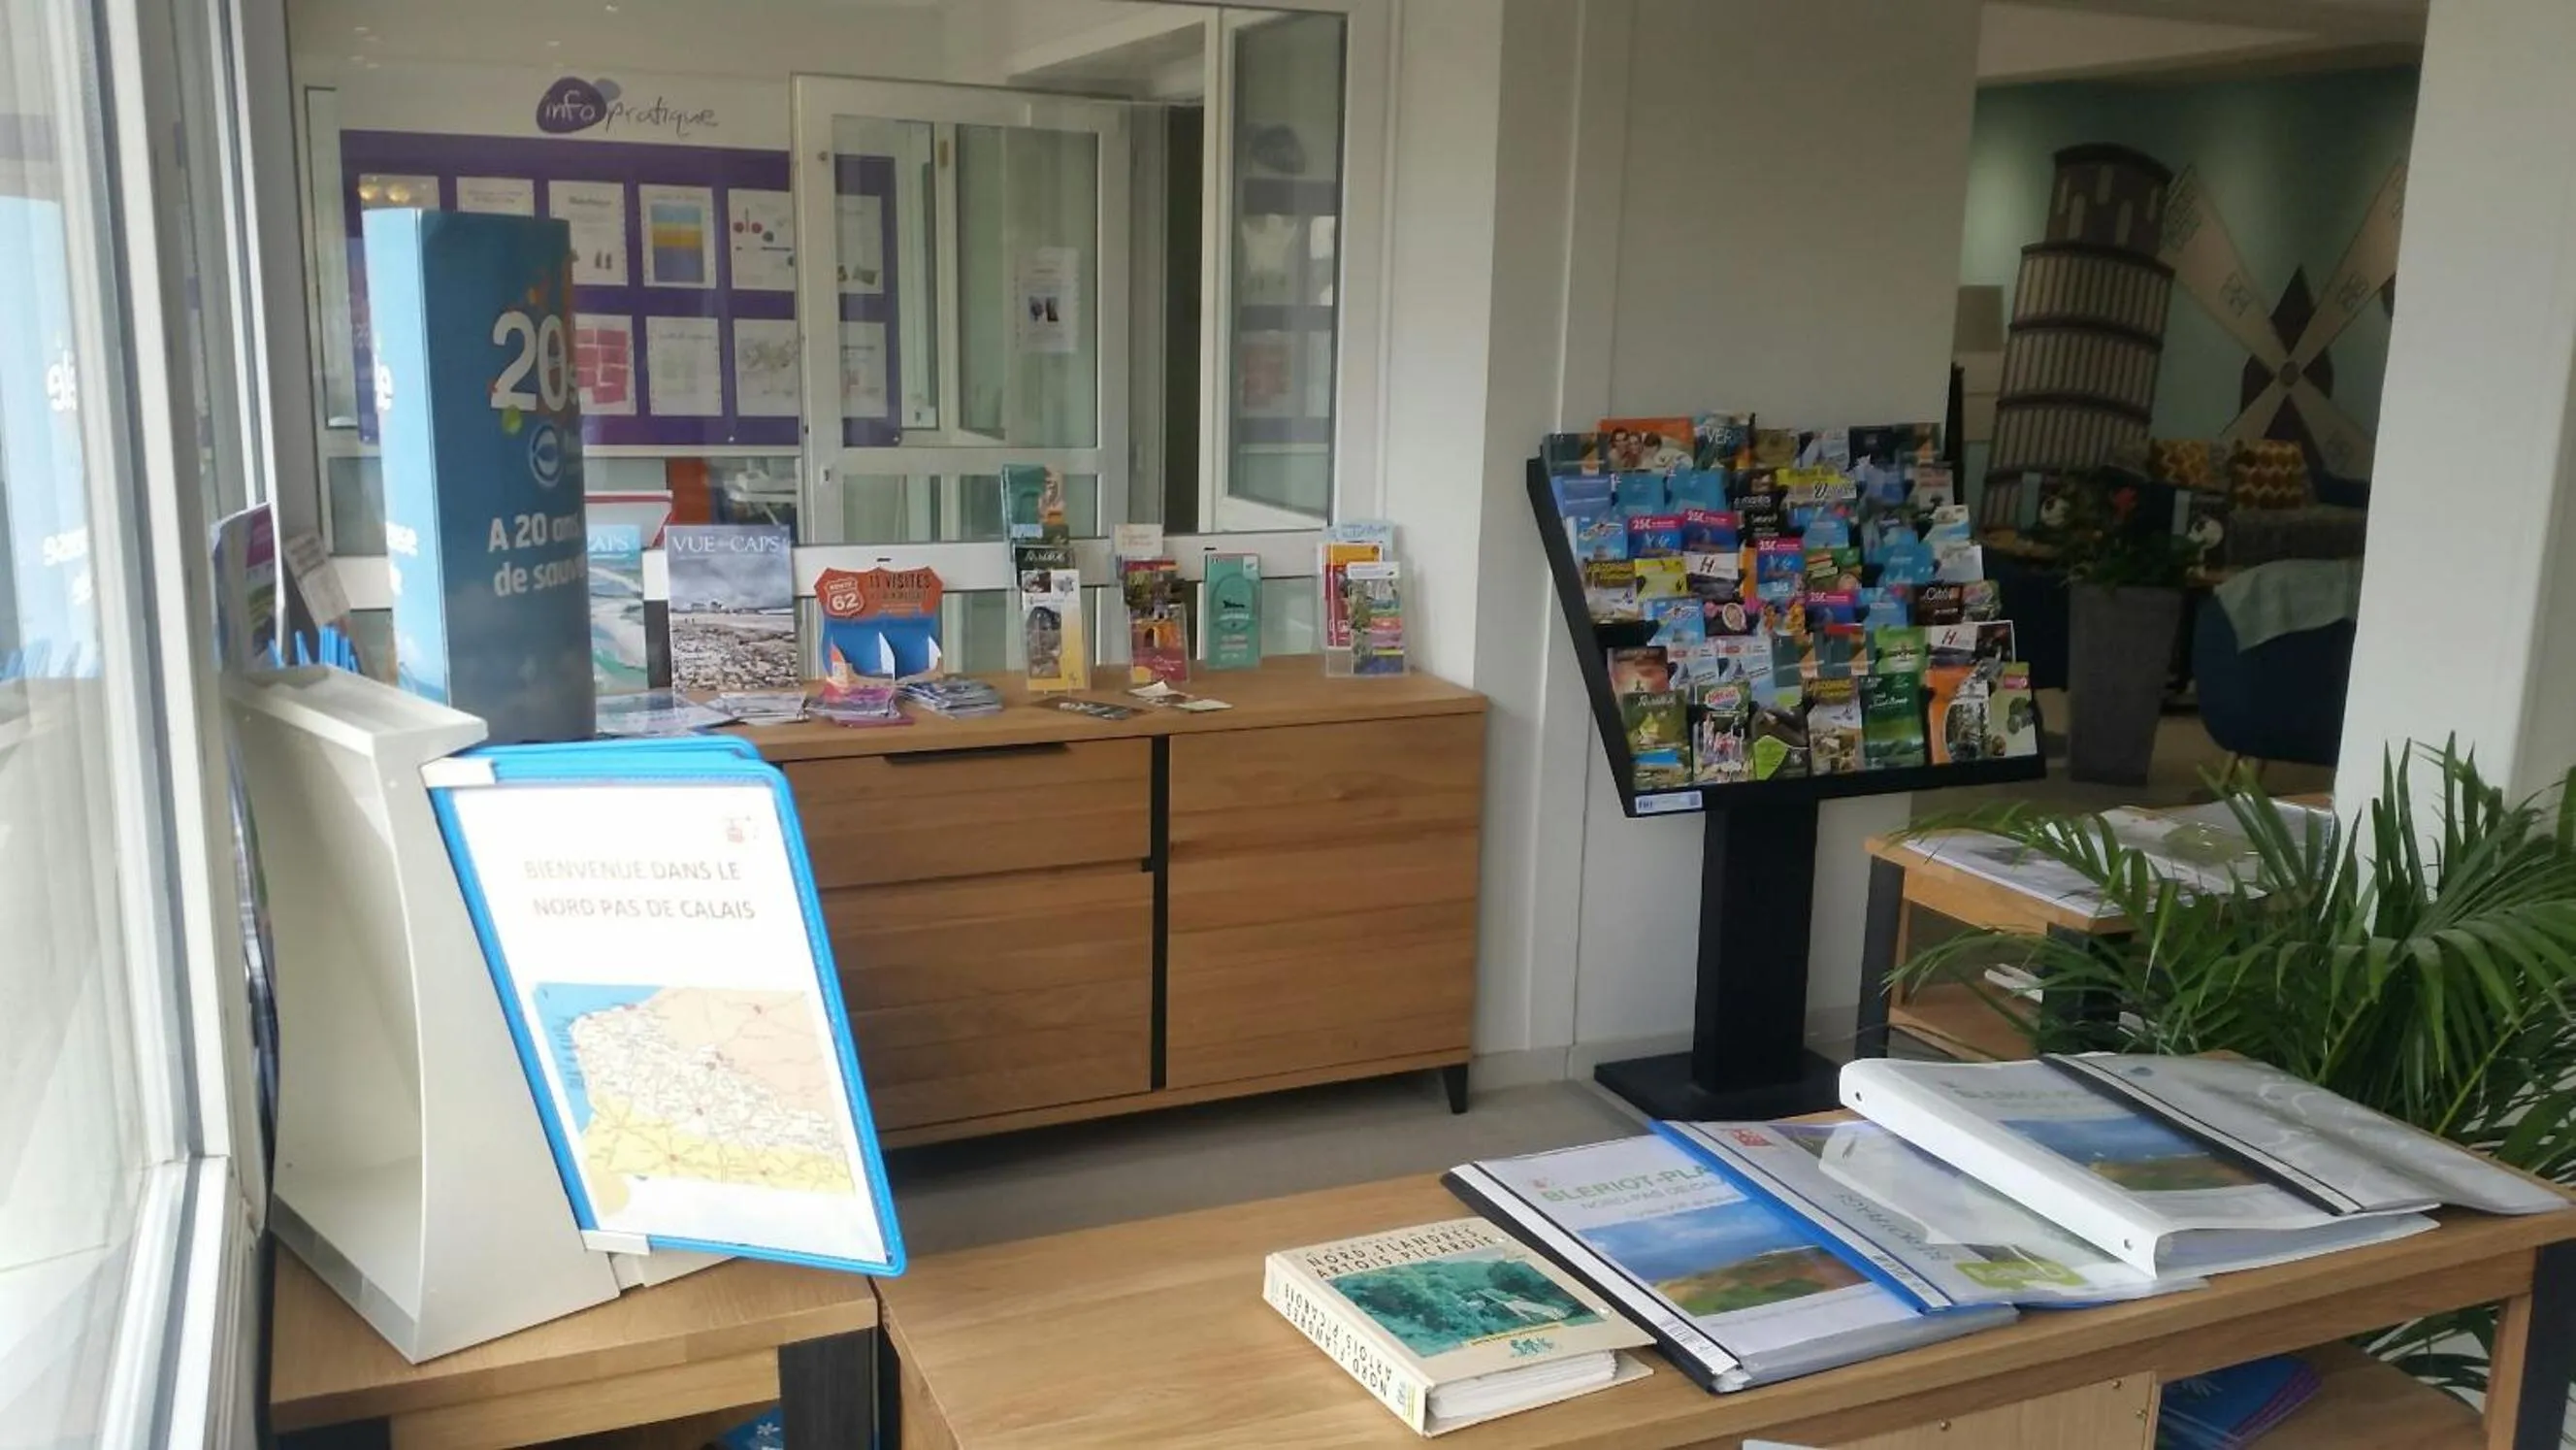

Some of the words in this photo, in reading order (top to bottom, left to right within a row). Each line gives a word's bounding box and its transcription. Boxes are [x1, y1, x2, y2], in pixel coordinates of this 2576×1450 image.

[545, 89, 596, 120] info
[605, 95, 720, 137] pratique
[490, 310, 568, 412] 20
[514, 512, 546, 548] 20
[670, 534, 716, 553] VUE
[730, 534, 782, 553] CAPS
[493, 560, 528, 598] de
[831, 592, 860, 611] 62
[524, 859, 648, 880] BIENVENUE
[650, 860, 712, 881] DANS
[717, 861, 741, 881] LE
[533, 898, 596, 917] NORD
[601, 898, 641, 918] PAS
[646, 898, 676, 918] DE
[680, 900, 756, 920] CALAIS
